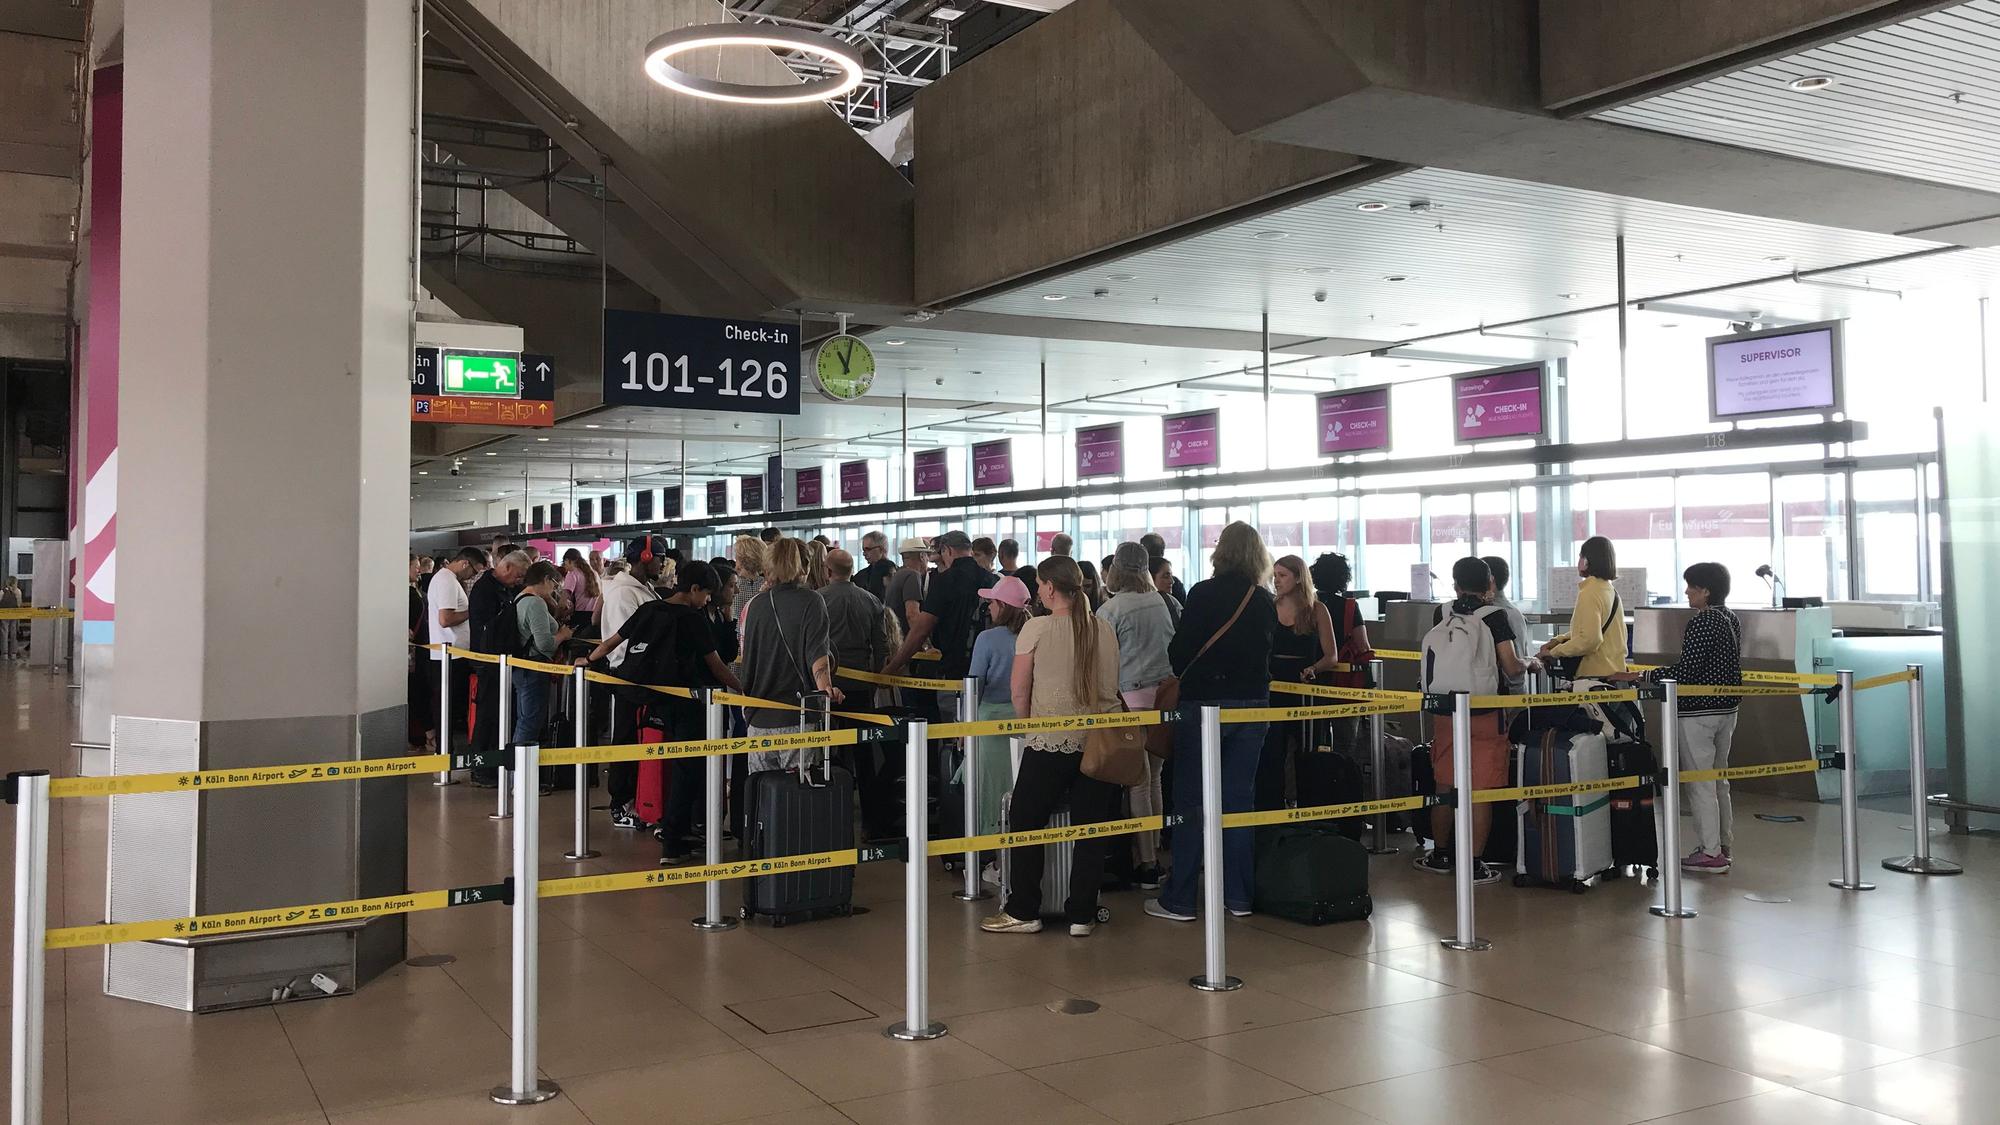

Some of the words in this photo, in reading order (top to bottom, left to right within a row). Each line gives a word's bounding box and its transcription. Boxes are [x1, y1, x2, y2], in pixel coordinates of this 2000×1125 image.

[725, 324, 789, 345] Check-in
[1740, 347, 1802, 364] SUPERVISOR
[621, 351, 788, 399] 101-126
[1494, 403, 1528, 414] CHECK-IN
[1703, 433, 1727, 449] 118
[1659, 519, 1719, 533] Euwings
[1013, 722, 1026, 730] Köln
[1027, 721, 1041, 729] Bonn
[1041, 720, 1061, 730] Airport
[1108, 716, 1121, 724] Bonn
[1122, 715, 1141, 724] Airport
[774, 737, 789, 745] Köln
[807, 735, 831, 744] Airport
[667, 745, 682, 754] Köln
[684, 744, 701, 752] Bonn
[703, 743, 728, 752] Airport
[343, 764, 361, 774] Köln
[364, 764, 384, 772] Bonn
[386, 761, 417, 771] Airport
[205, 775, 225, 784] Köln
[228, 774, 249, 783] Bonn
[252, 771, 285, 782] Airport
[1110, 824, 1123, 832] Bonn
[1124, 822, 1143, 831] Airport
[1015, 834, 1028, 843] Köln
[1029, 833, 1042, 841] Bonn
[1043, 831, 1064, 841] Airport
[774, 861, 788, 869] Köln
[790, 859, 806, 867] Bonn
[807, 856, 831, 866] Airport
[667, 872, 682, 881] Köln
[684, 871, 701, 879] Bonn
[703, 868, 729, 878] Airport
[340, 905, 359, 915] Köln
[362, 904, 382, 913] Bonn
[384, 899, 414, 911] Airport
[201, 920, 222, 930] Köln
[224, 918, 246, 928] Bonn
[249, 914, 281, 926] Airport
